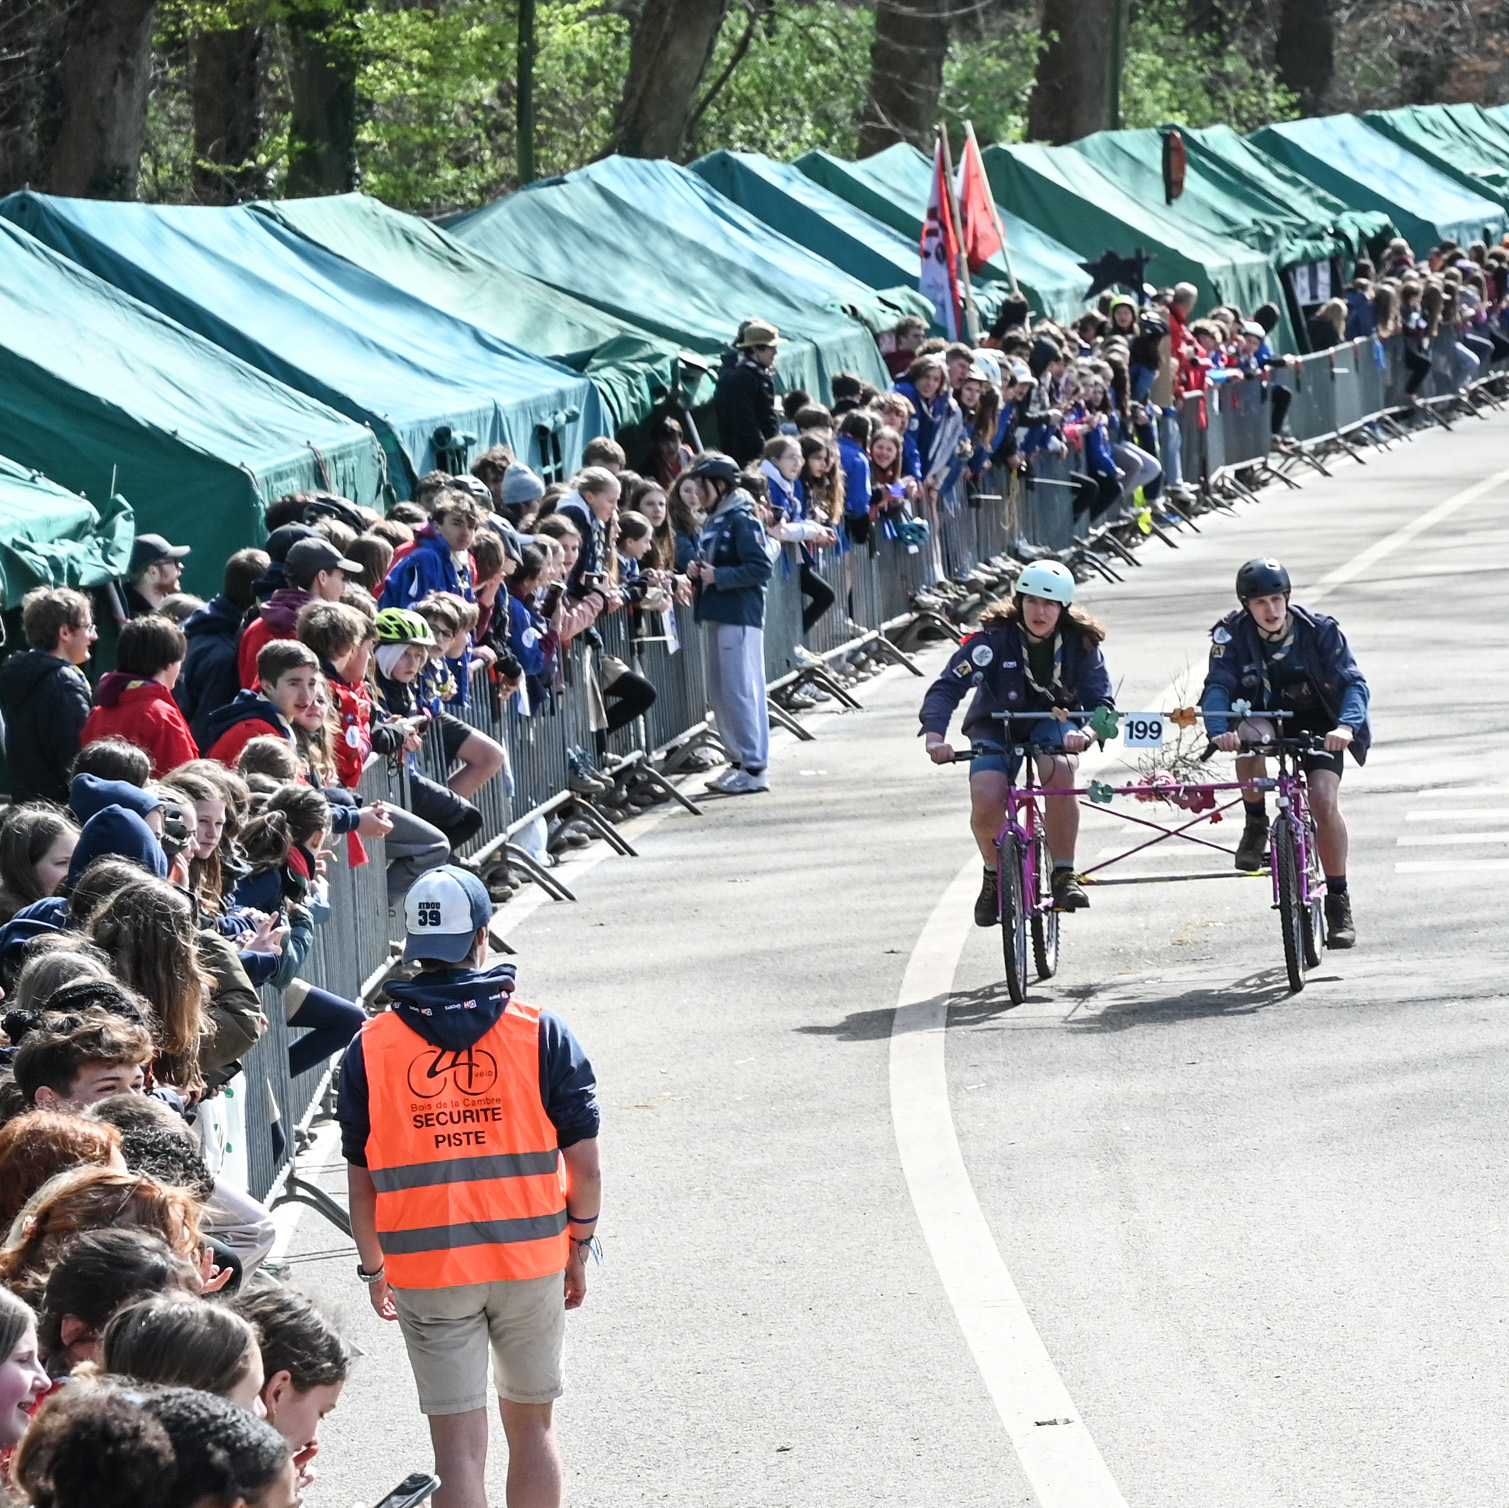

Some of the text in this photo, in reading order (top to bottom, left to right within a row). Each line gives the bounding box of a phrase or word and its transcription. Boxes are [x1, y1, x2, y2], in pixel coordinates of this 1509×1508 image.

[1125, 720, 1162, 740] 199
[418, 909, 441, 926] 39
[410, 1096, 501, 1113] Bois de la Cambre
[412, 1107, 502, 1129] SECURITE
[434, 1130, 486, 1149] PISTE
